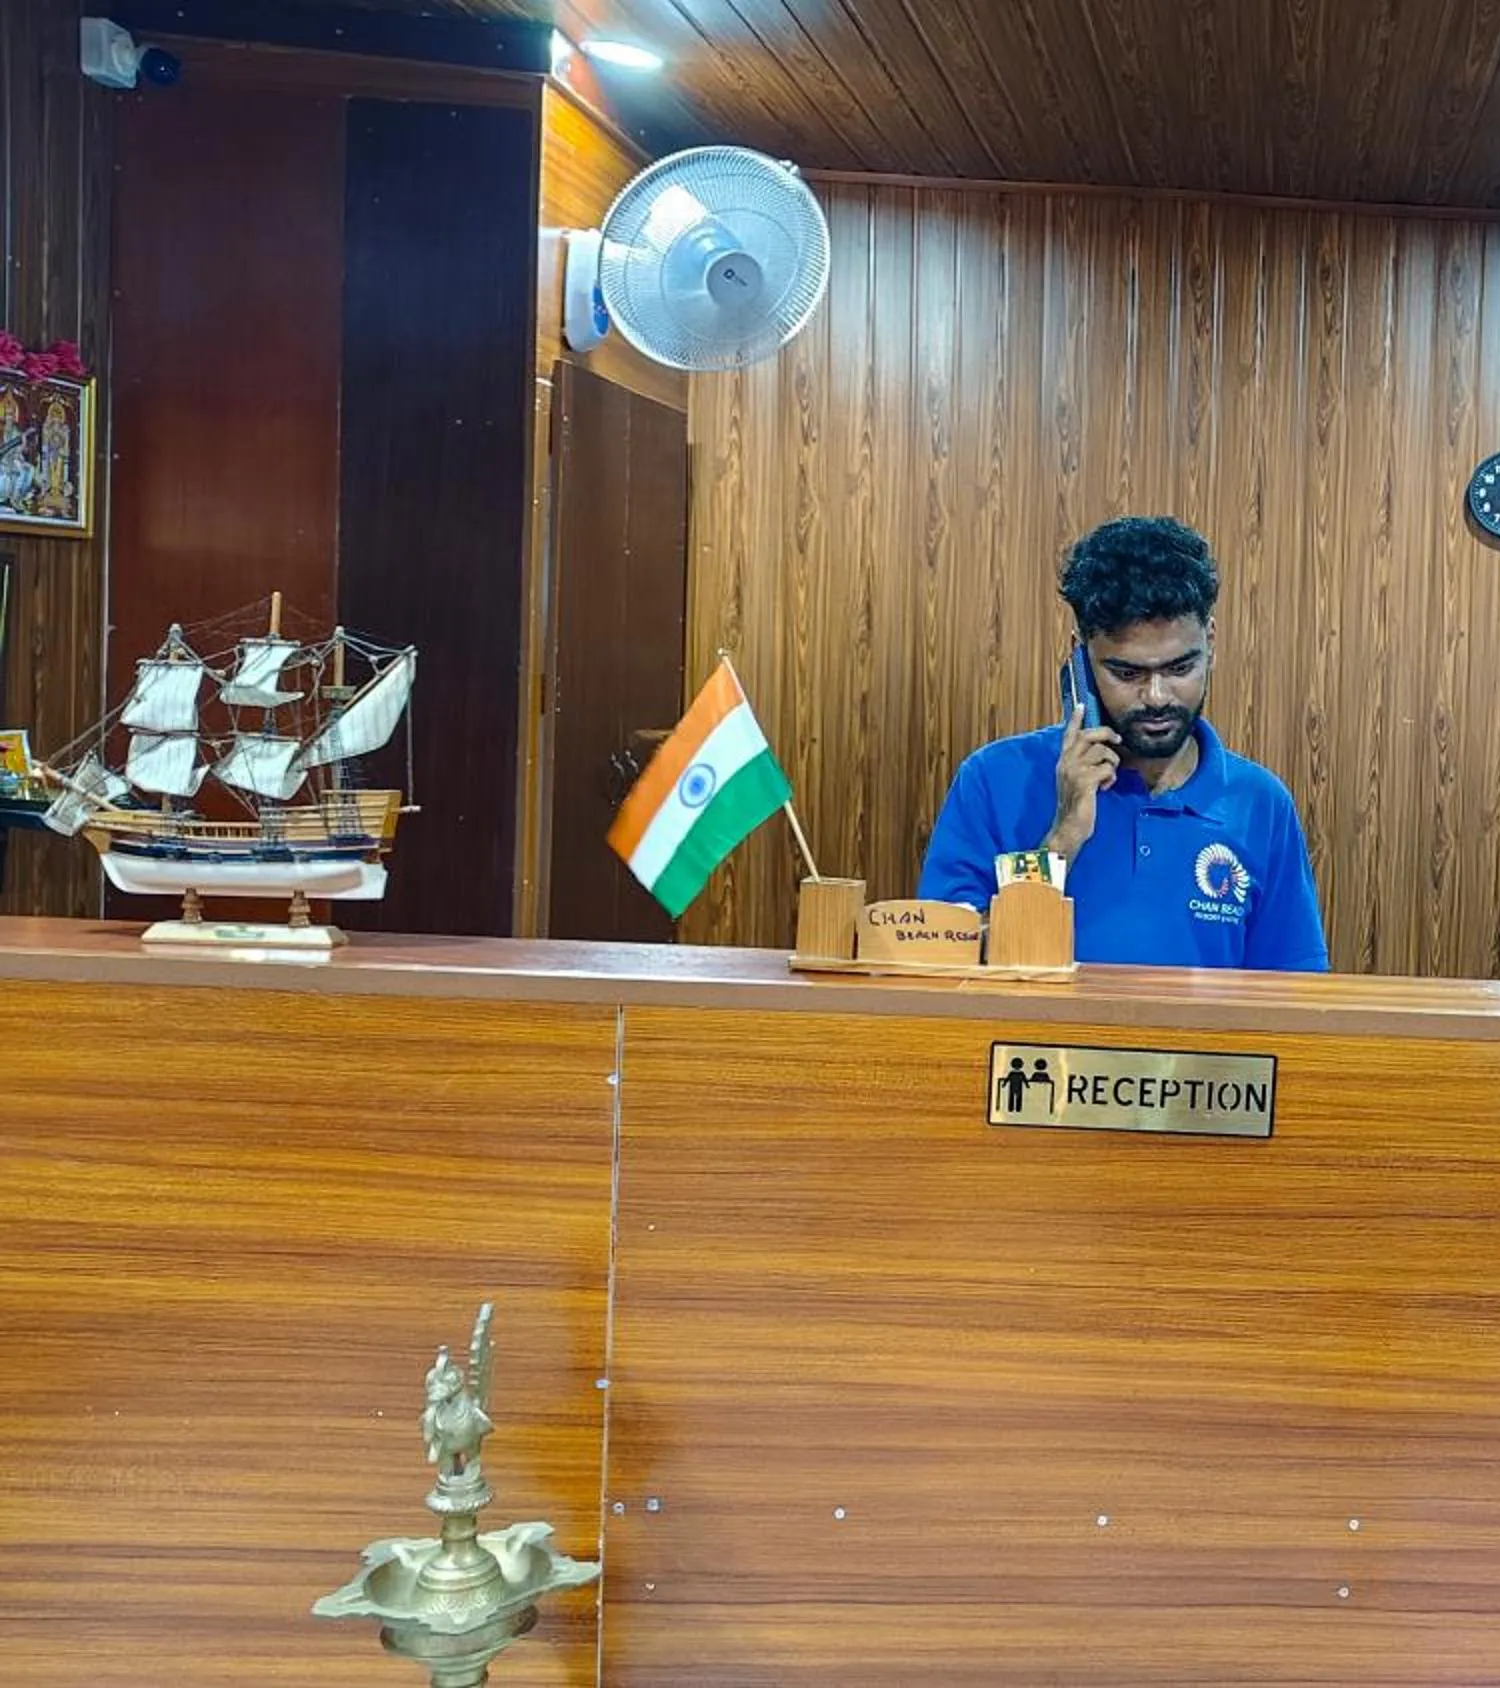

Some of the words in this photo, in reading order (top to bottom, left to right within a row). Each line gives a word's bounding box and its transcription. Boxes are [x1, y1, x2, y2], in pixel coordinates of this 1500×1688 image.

[1189, 899, 1220, 912] CHAN
[869, 906, 926, 926] CHAN
[896, 929, 939, 941] BEACH
[1067, 1073, 1267, 1113] RECEPTION
